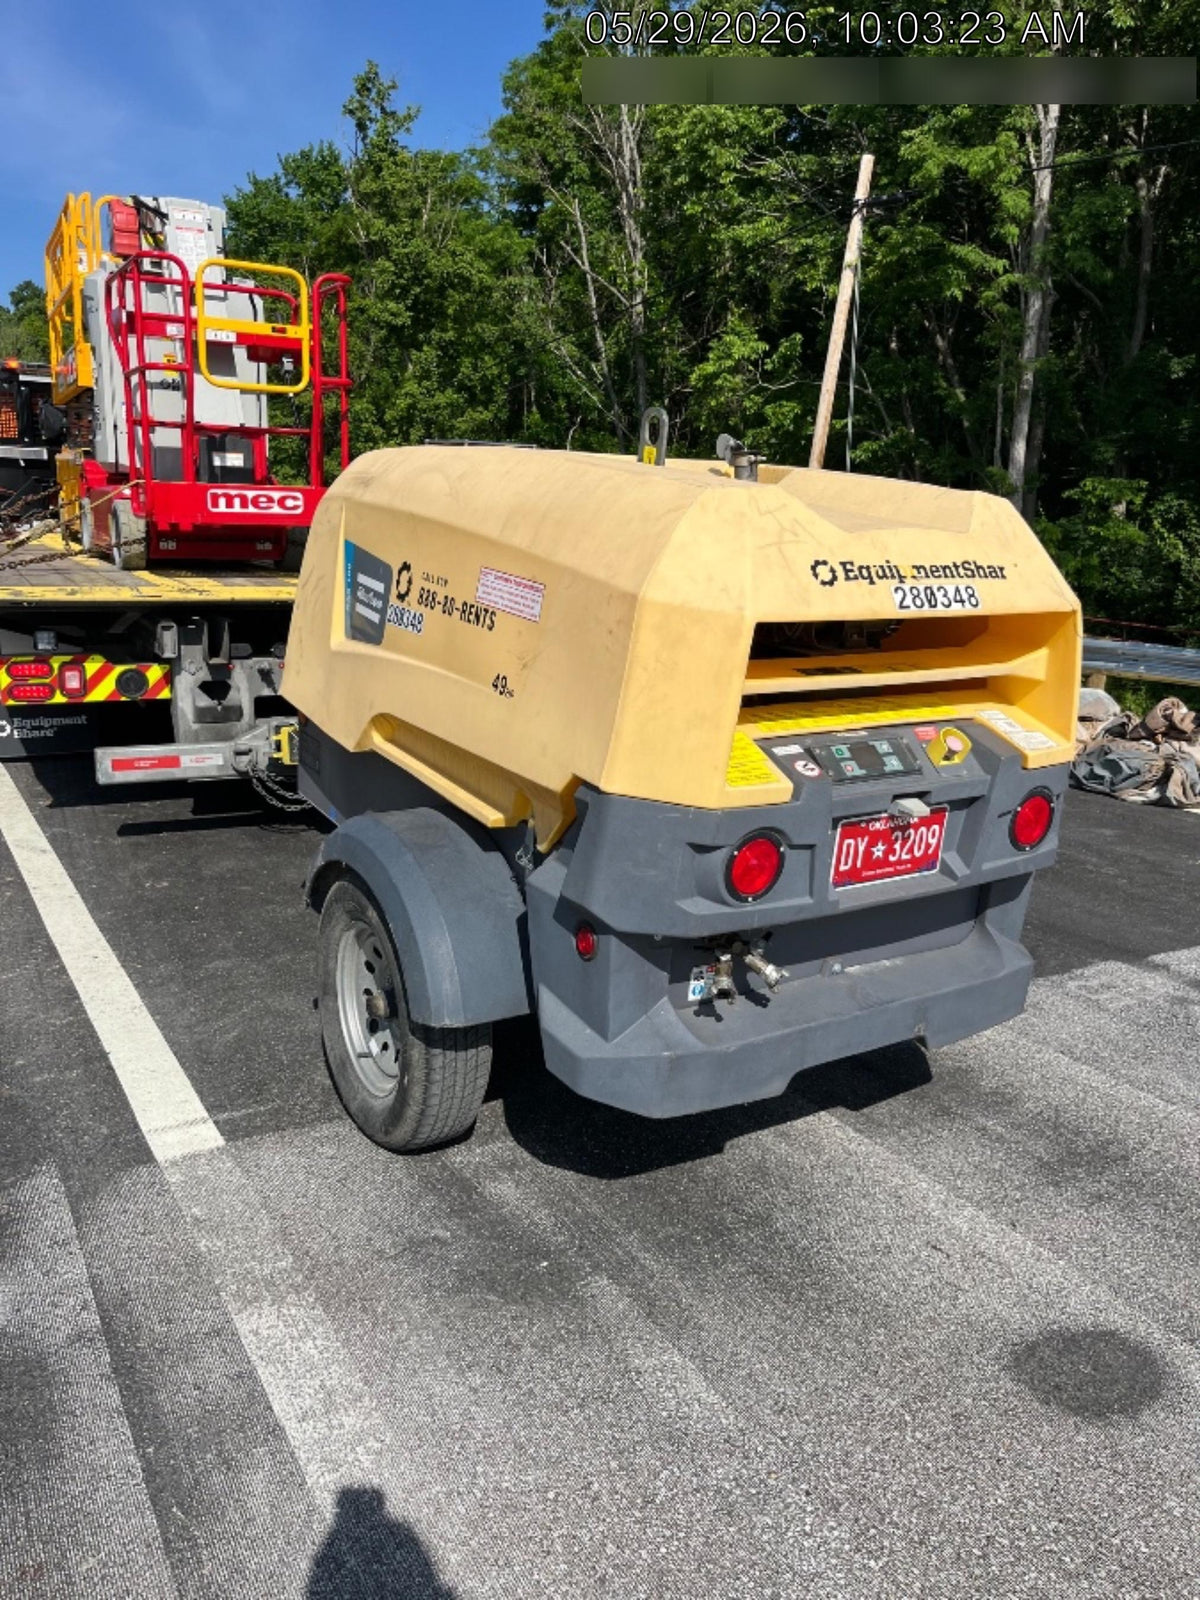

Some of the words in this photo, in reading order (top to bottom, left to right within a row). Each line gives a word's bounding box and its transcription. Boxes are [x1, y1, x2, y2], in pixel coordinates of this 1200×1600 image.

[209, 491, 302, 511] mec
[894, 585, 980, 610] 280348
[12, 714, 88, 729] Equipment
[13, 728, 54, 739] Share
[838, 835, 869, 872] DY
[888, 824, 940, 862] 3209
